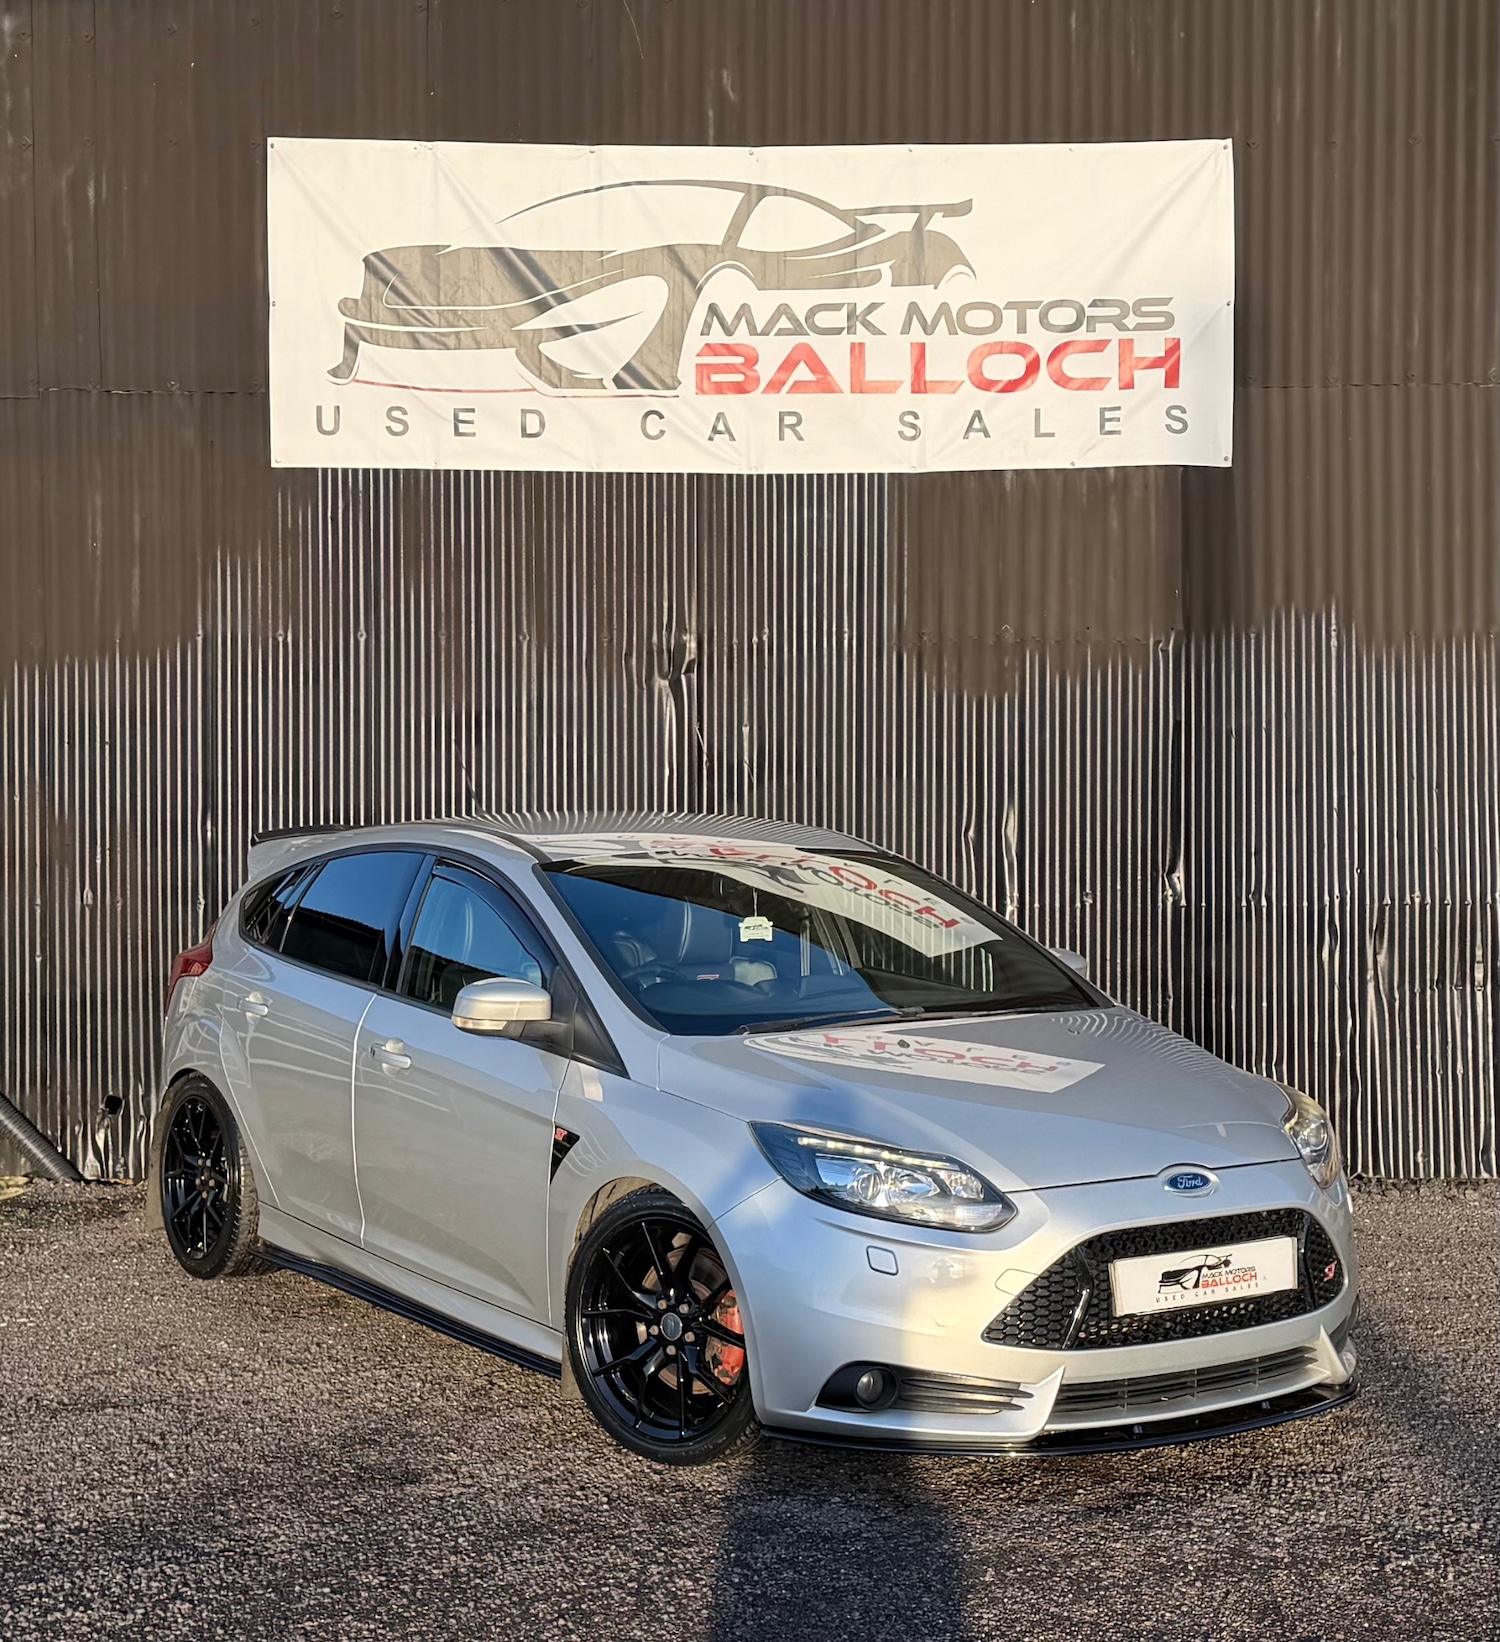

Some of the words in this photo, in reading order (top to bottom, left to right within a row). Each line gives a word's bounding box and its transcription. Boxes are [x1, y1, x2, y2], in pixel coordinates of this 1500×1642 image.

[700, 301, 887, 336] MACK
[900, 297, 1177, 336] MOTORS
[694, 337, 1181, 395] BALLOCH
[315, 404, 547, 440] USED
[640, 409, 806, 443] CAR
[897, 404, 1190, 441] SALES
[1177, 1174, 1204, 1189] Ford
[1201, 1271, 1224, 1280] MACK
[1224, 1265, 1256, 1277] MOTORS
[1201, 1271, 1258, 1289] BALLOCH
[1155, 1293, 1186, 1303] USED
[1194, 1288, 1216, 1298] CAR
[1224, 1281, 1260, 1293] SALES
